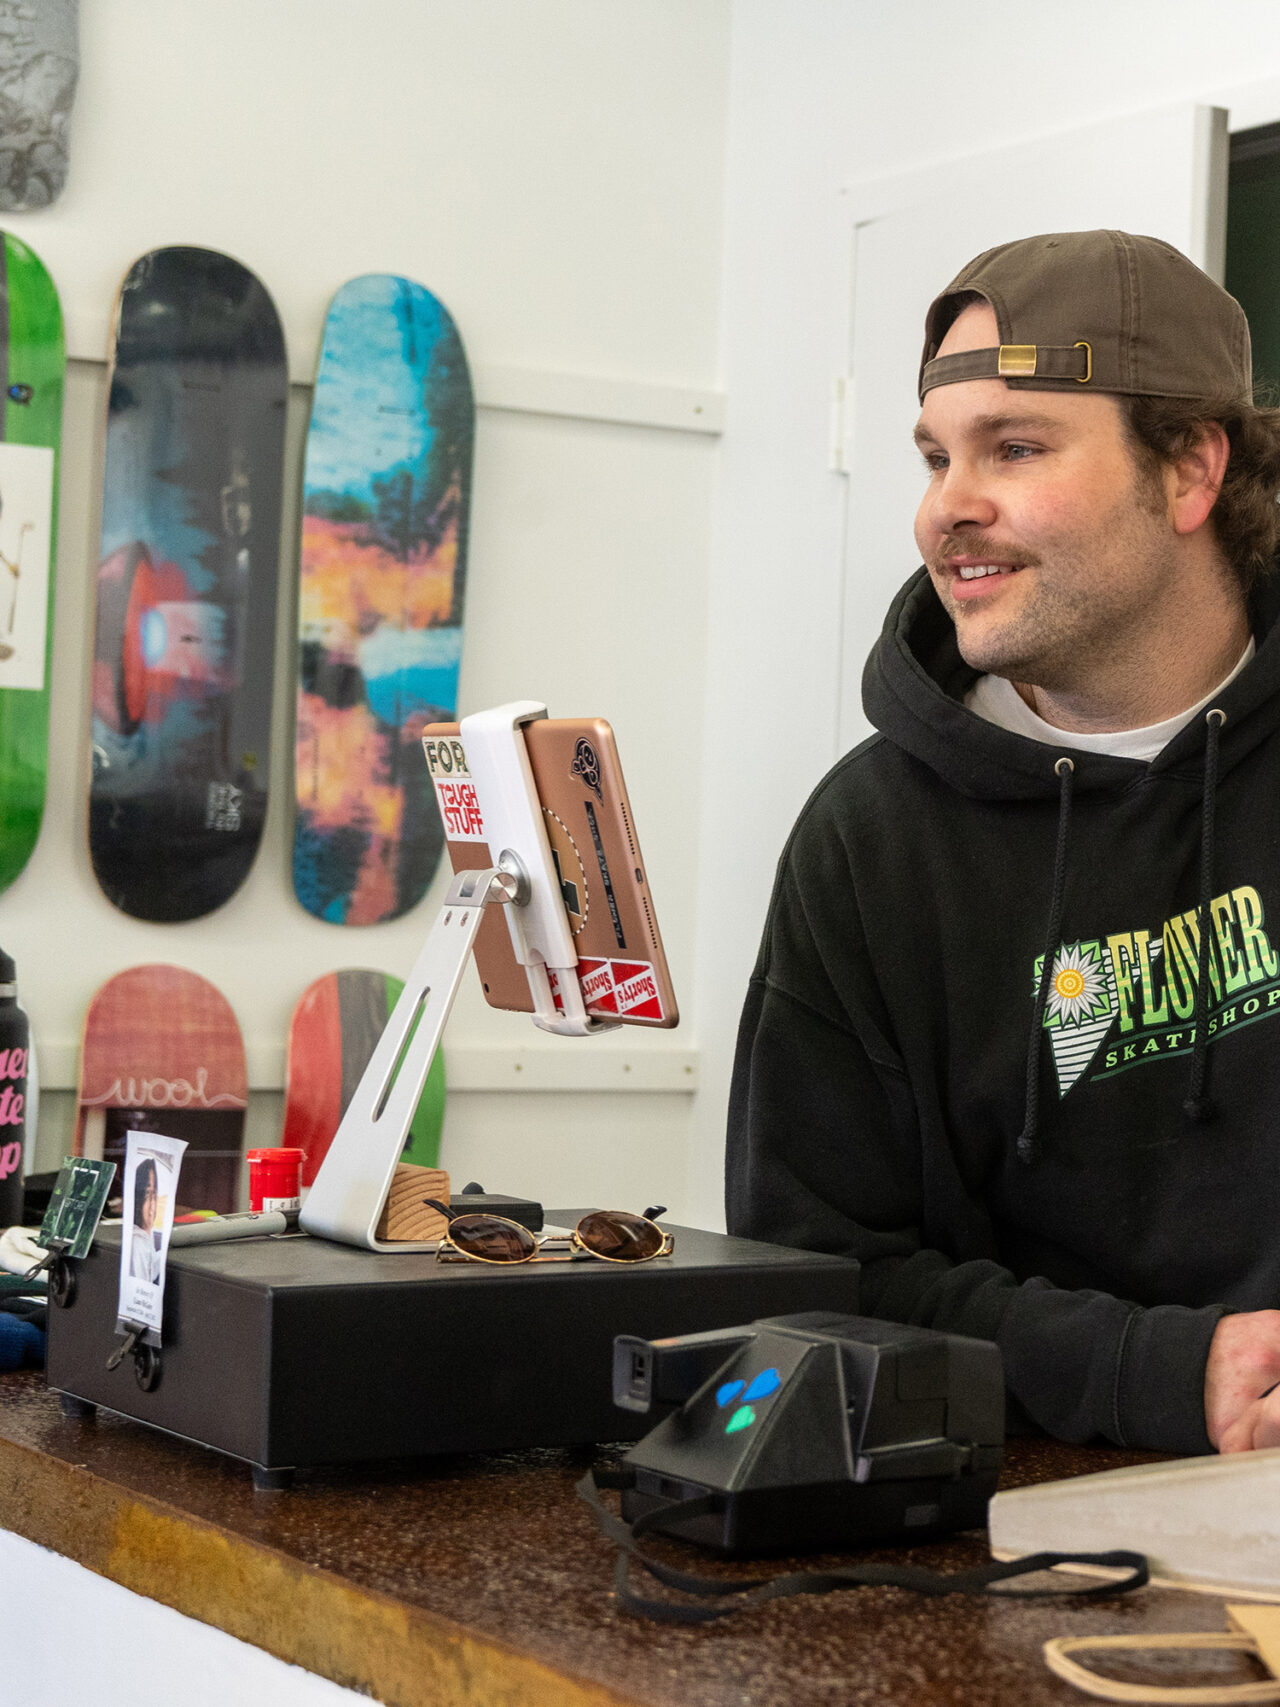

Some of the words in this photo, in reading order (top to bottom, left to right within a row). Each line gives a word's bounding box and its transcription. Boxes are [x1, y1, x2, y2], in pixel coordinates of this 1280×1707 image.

[425, 741, 469, 773] FOR
[437, 782, 477, 807] TOUGH
[445, 807, 483, 836] STUFF
[1106, 885, 1280, 1033] FLOWER
[100, 1066, 225, 1108] wool
